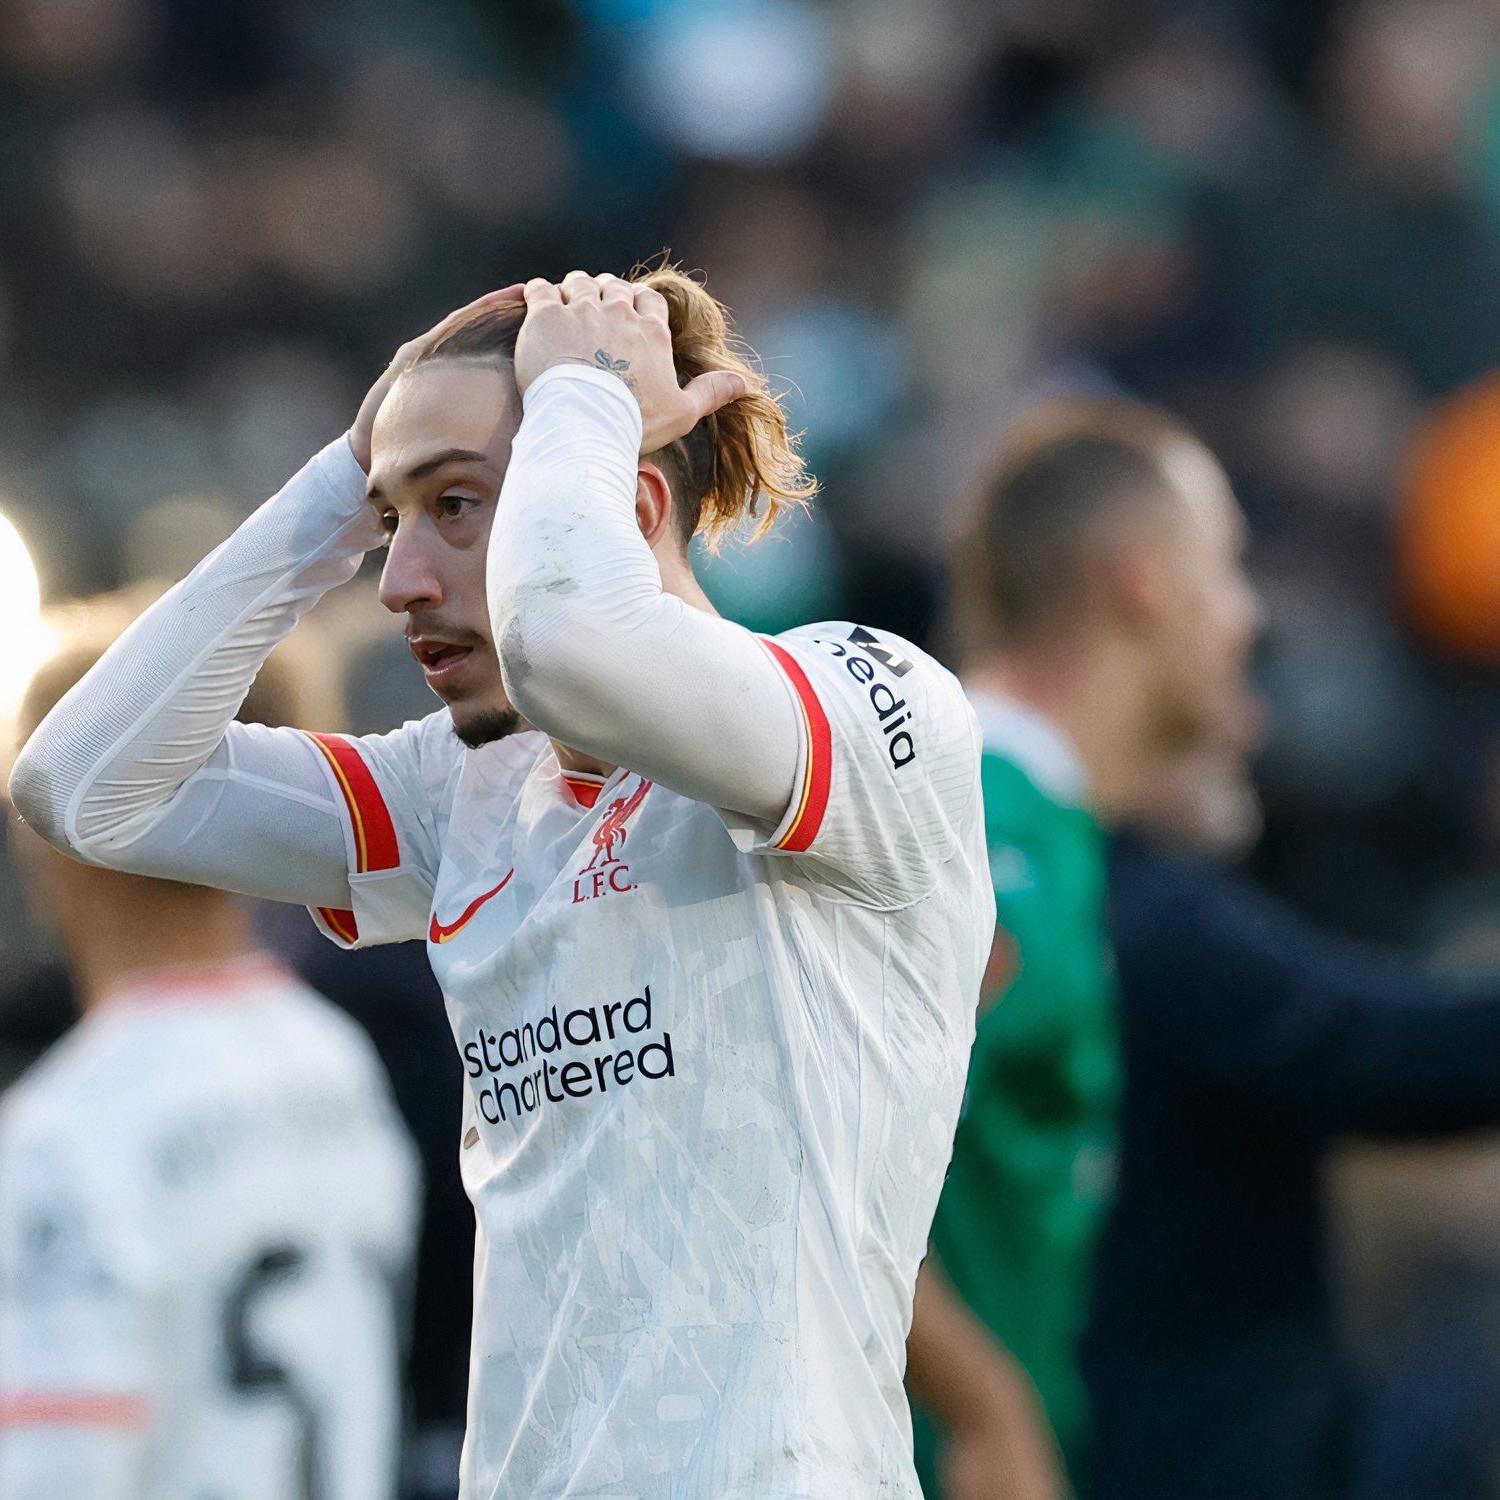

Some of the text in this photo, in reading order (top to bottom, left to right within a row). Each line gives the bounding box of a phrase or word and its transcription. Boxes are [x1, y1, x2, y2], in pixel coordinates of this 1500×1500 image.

[572, 865, 638, 904] L.F.C.
[463, 984, 652, 1079] standard
[479, 1031, 675, 1125] chartered
